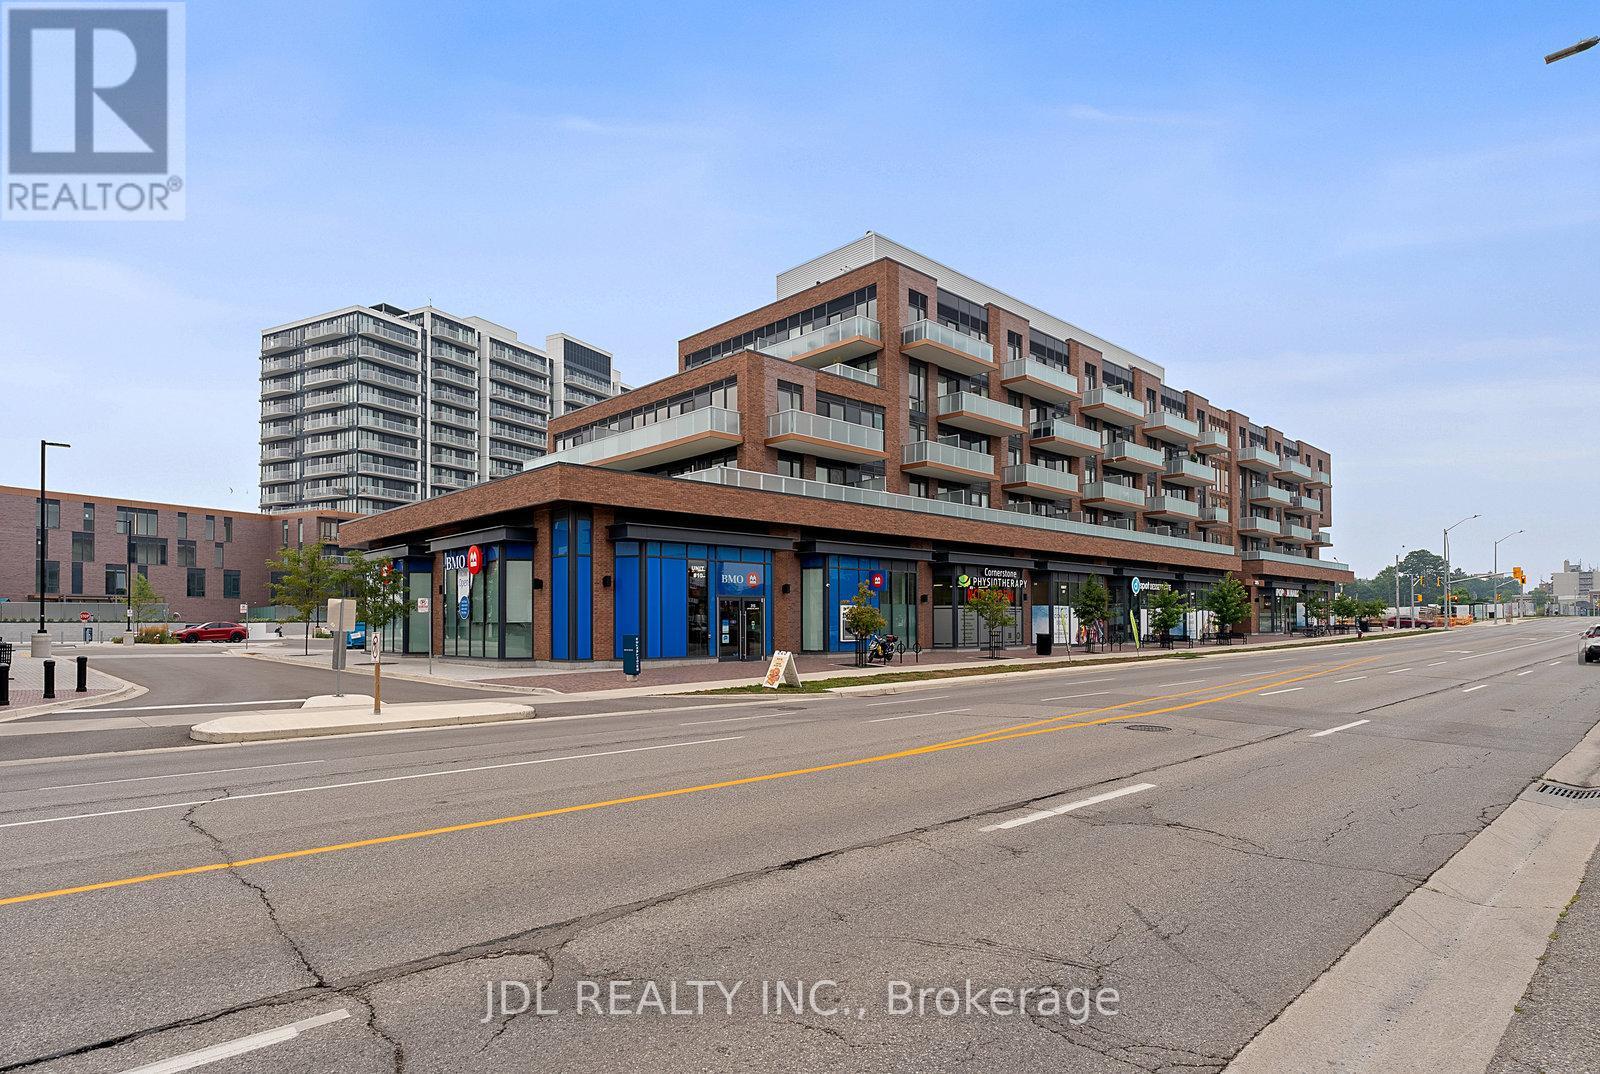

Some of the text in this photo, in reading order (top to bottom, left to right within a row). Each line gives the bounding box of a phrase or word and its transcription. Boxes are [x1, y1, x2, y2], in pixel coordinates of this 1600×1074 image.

[446, 555, 466, 570] BMO
[984, 568, 1017, 578] Cornerstone
[721, 575, 744, 584] BMO
[972, 577, 1028, 588] PHYSIOTHERAPY
